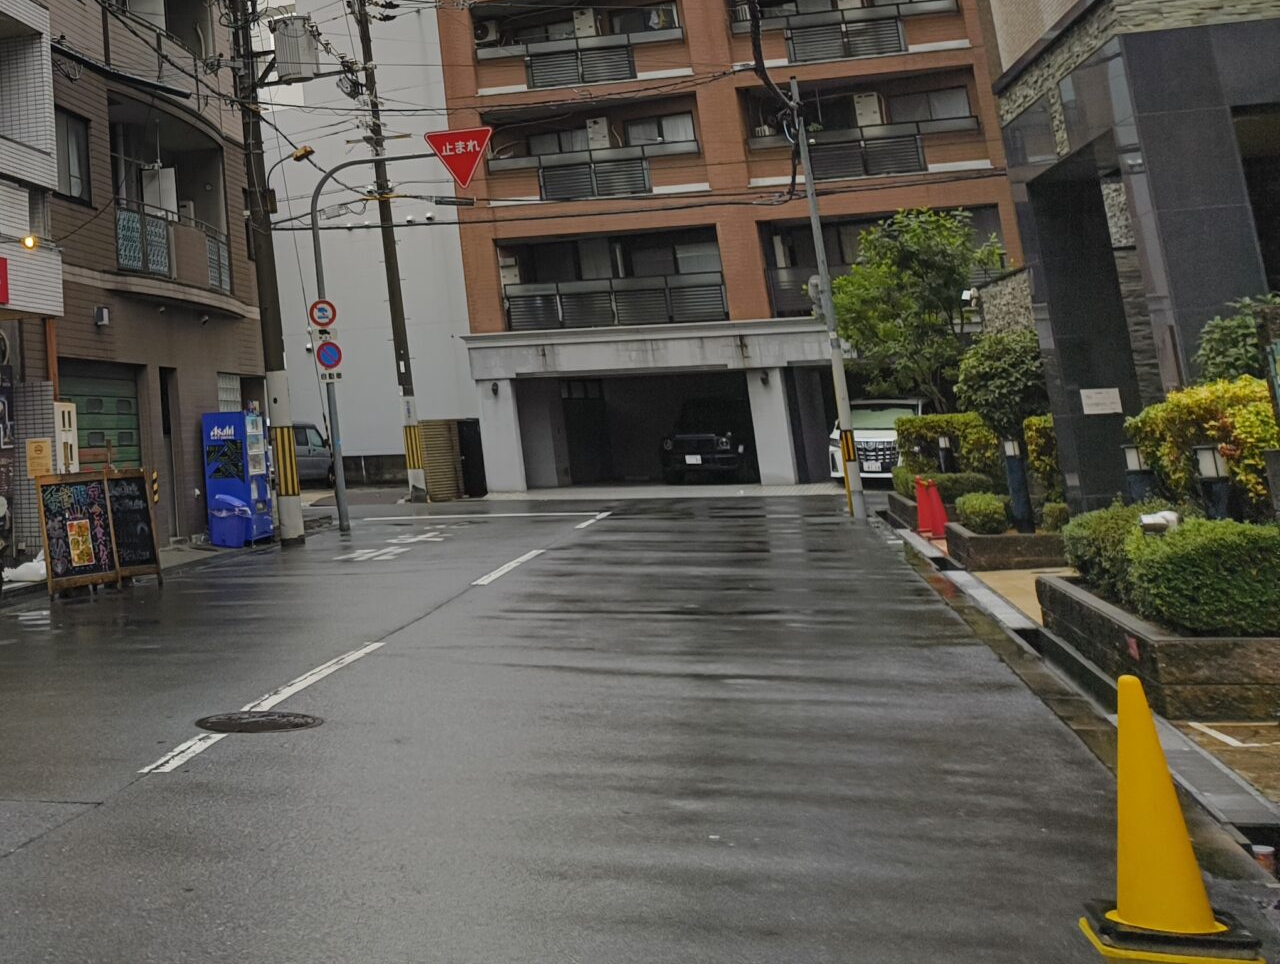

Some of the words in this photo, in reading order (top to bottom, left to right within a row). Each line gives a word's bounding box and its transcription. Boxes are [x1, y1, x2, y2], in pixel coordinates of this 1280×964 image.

[441, 139, 480, 156] 止まれ
[210, 425, 235, 437] Asahi
